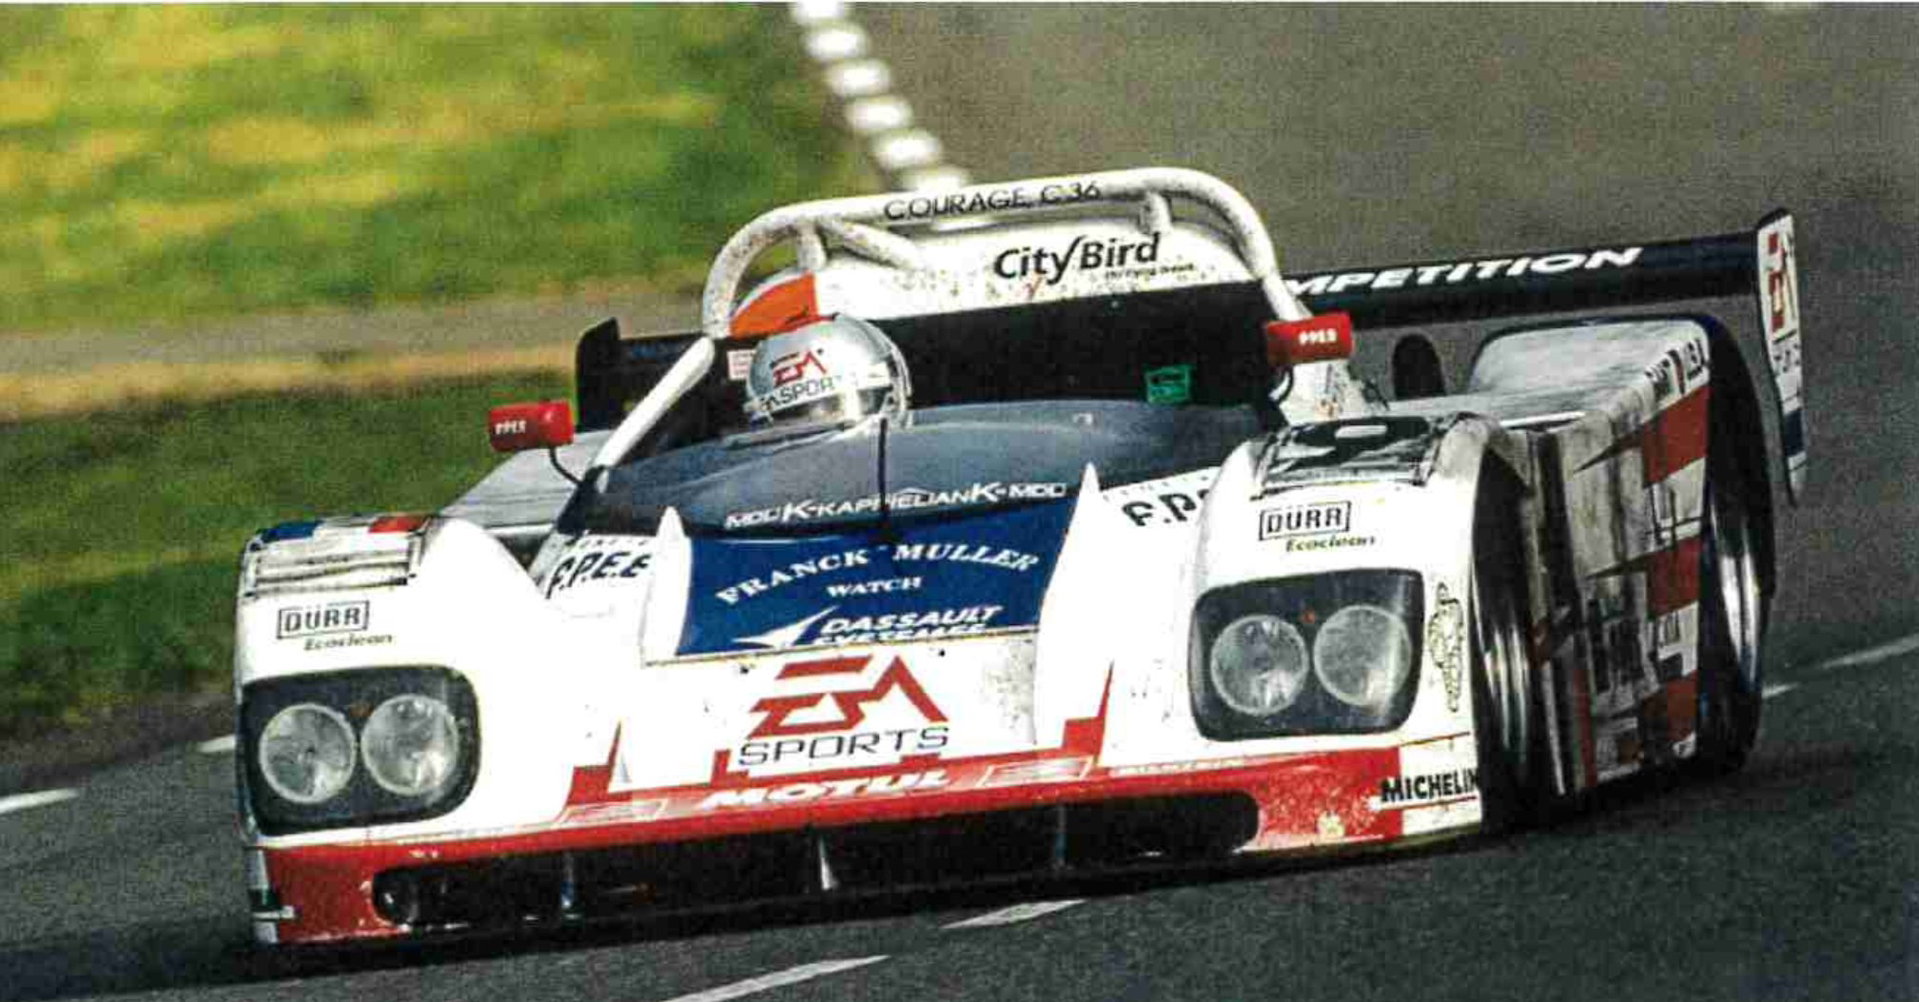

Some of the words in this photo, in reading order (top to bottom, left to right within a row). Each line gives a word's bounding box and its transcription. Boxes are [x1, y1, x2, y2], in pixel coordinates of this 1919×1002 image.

[884, 188, 1029, 221] COURAGE
[715, 548, 871, 605] FRANCK
[892, 543, 1040, 573] MULLER
[826, 575, 923, 598] WATCH
[820, 604, 1004, 634] DASSAULT
[747, 654, 950, 740] EA
[738, 725, 951, 766] SPORTS
[700, 767, 952, 812] MOTUL
[1381, 766, 1480, 803] MICHELIN
